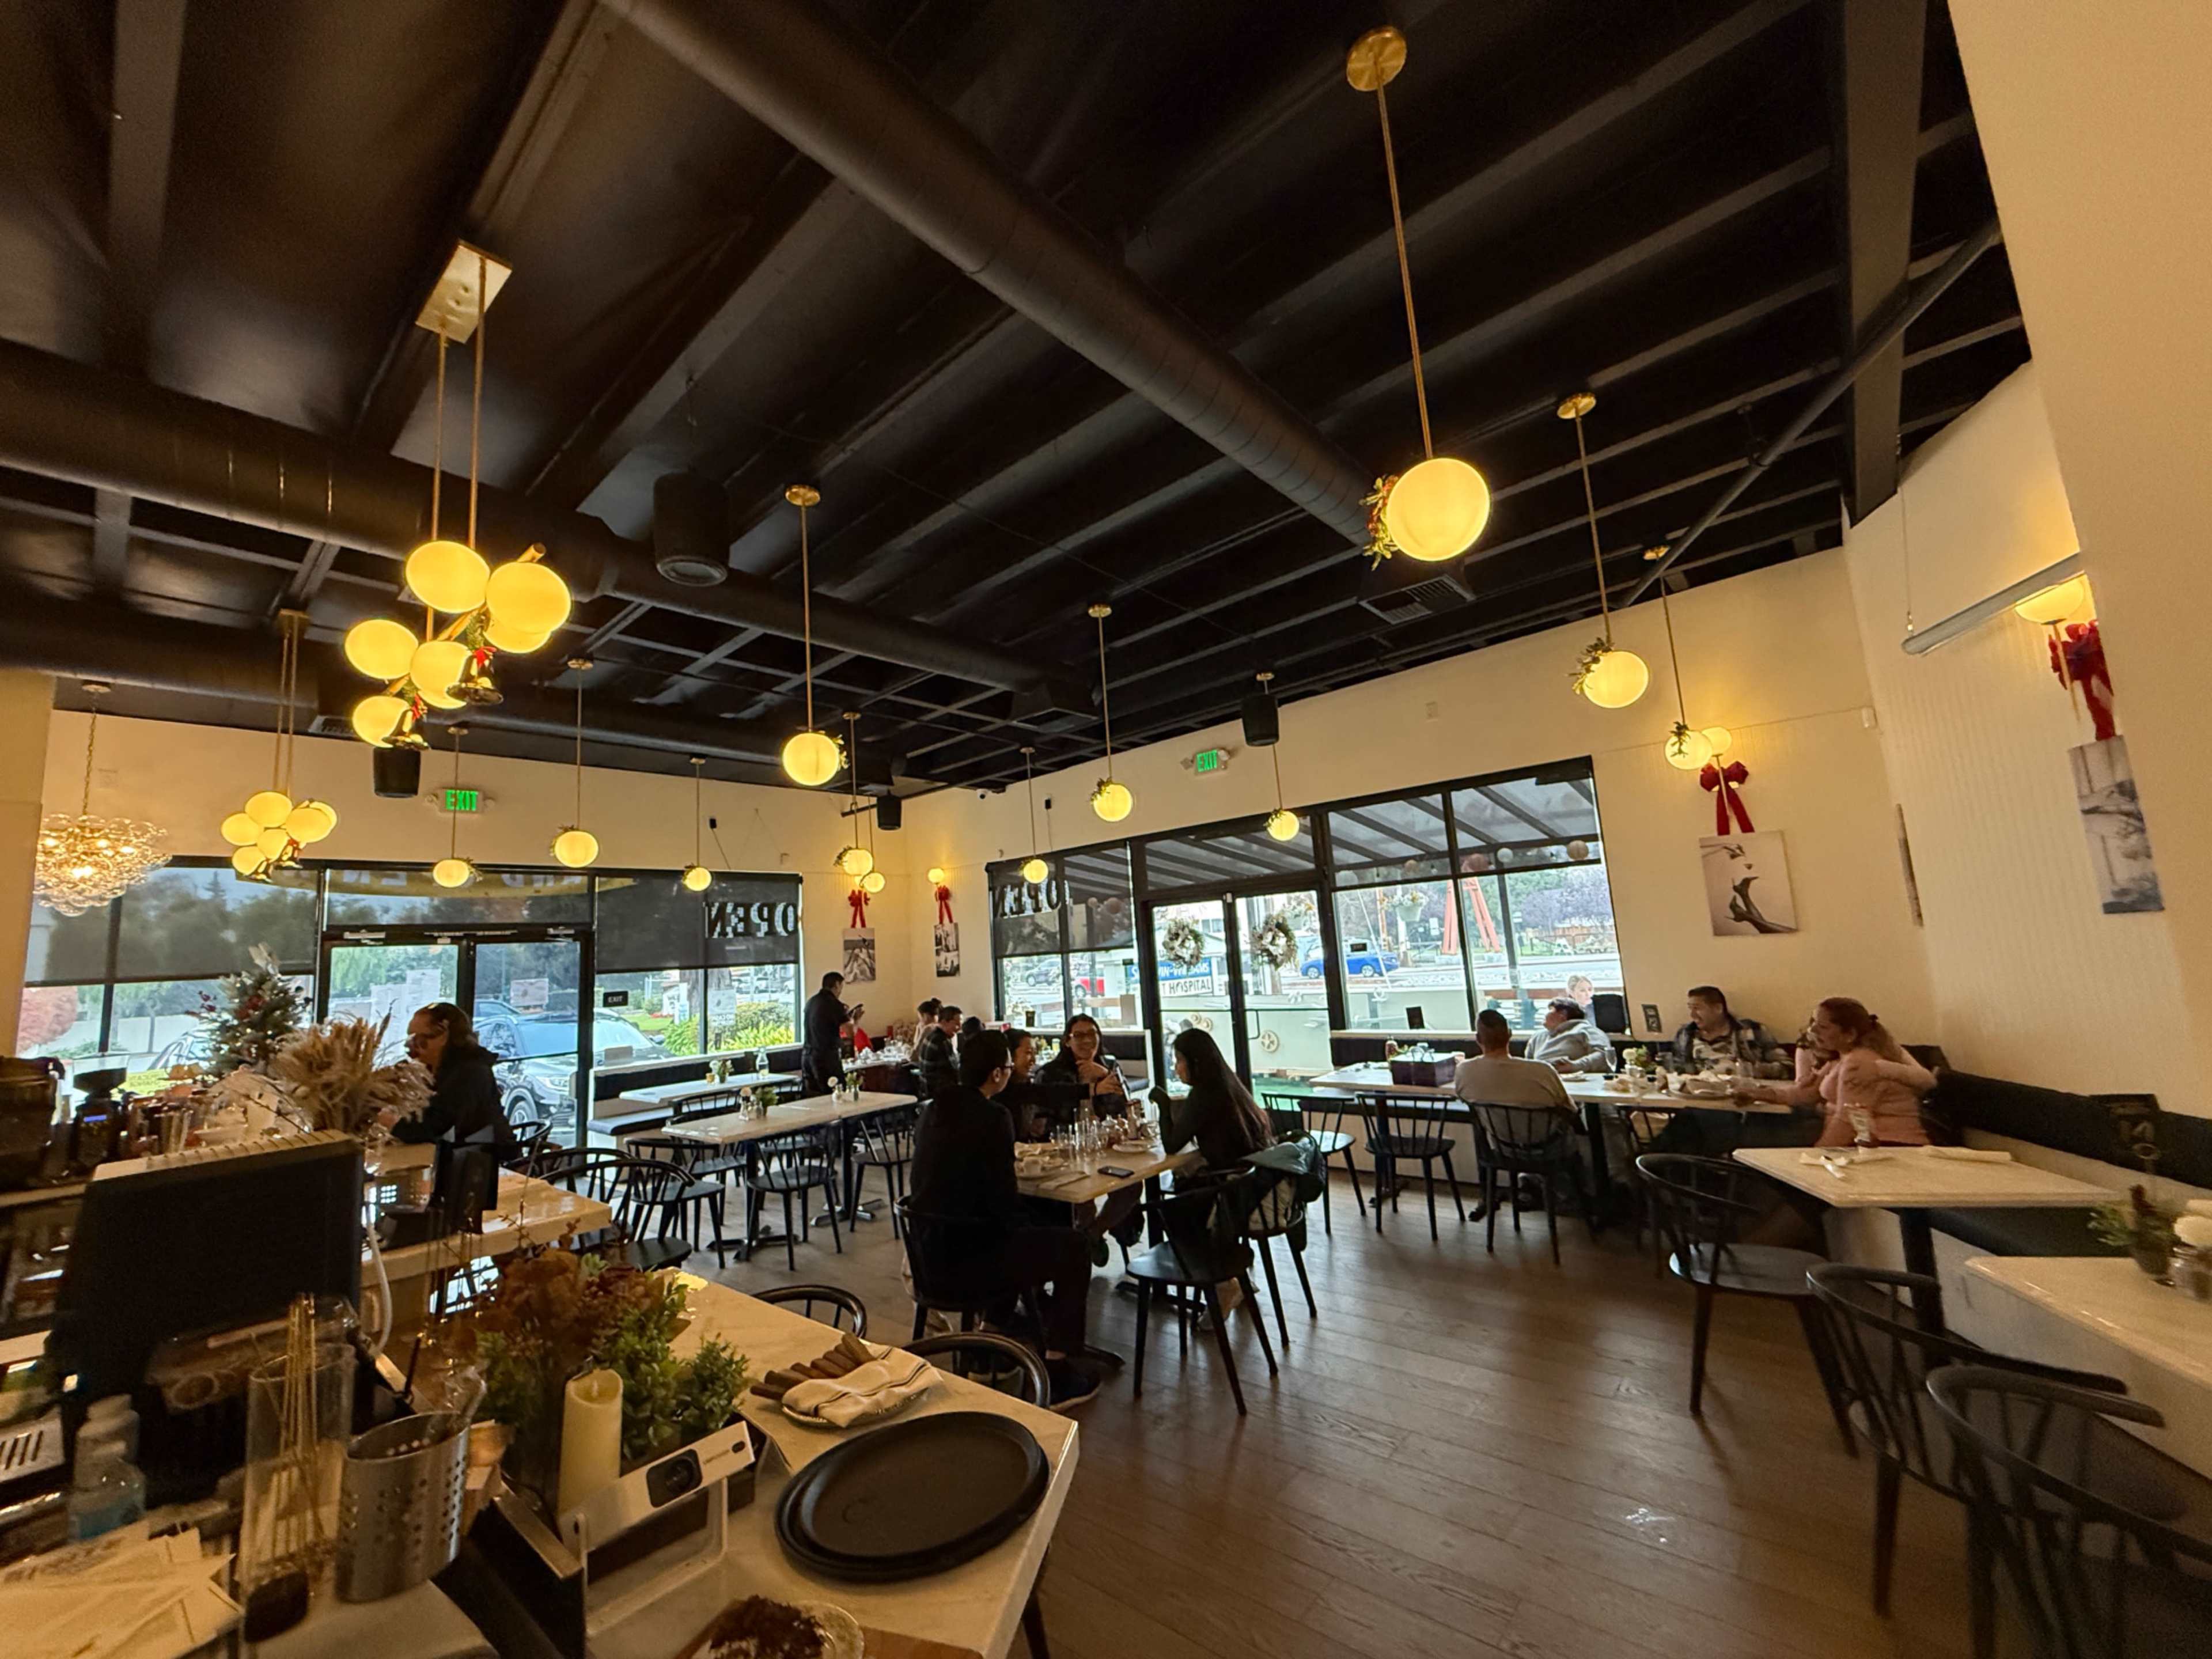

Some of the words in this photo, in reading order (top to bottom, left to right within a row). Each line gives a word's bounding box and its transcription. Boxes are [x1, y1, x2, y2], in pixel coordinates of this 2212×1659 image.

[1197, 749, 1217, 772] EXIT
[446, 790, 479, 811] EXIT
[1169, 978, 1210, 994] HOSPITAL
